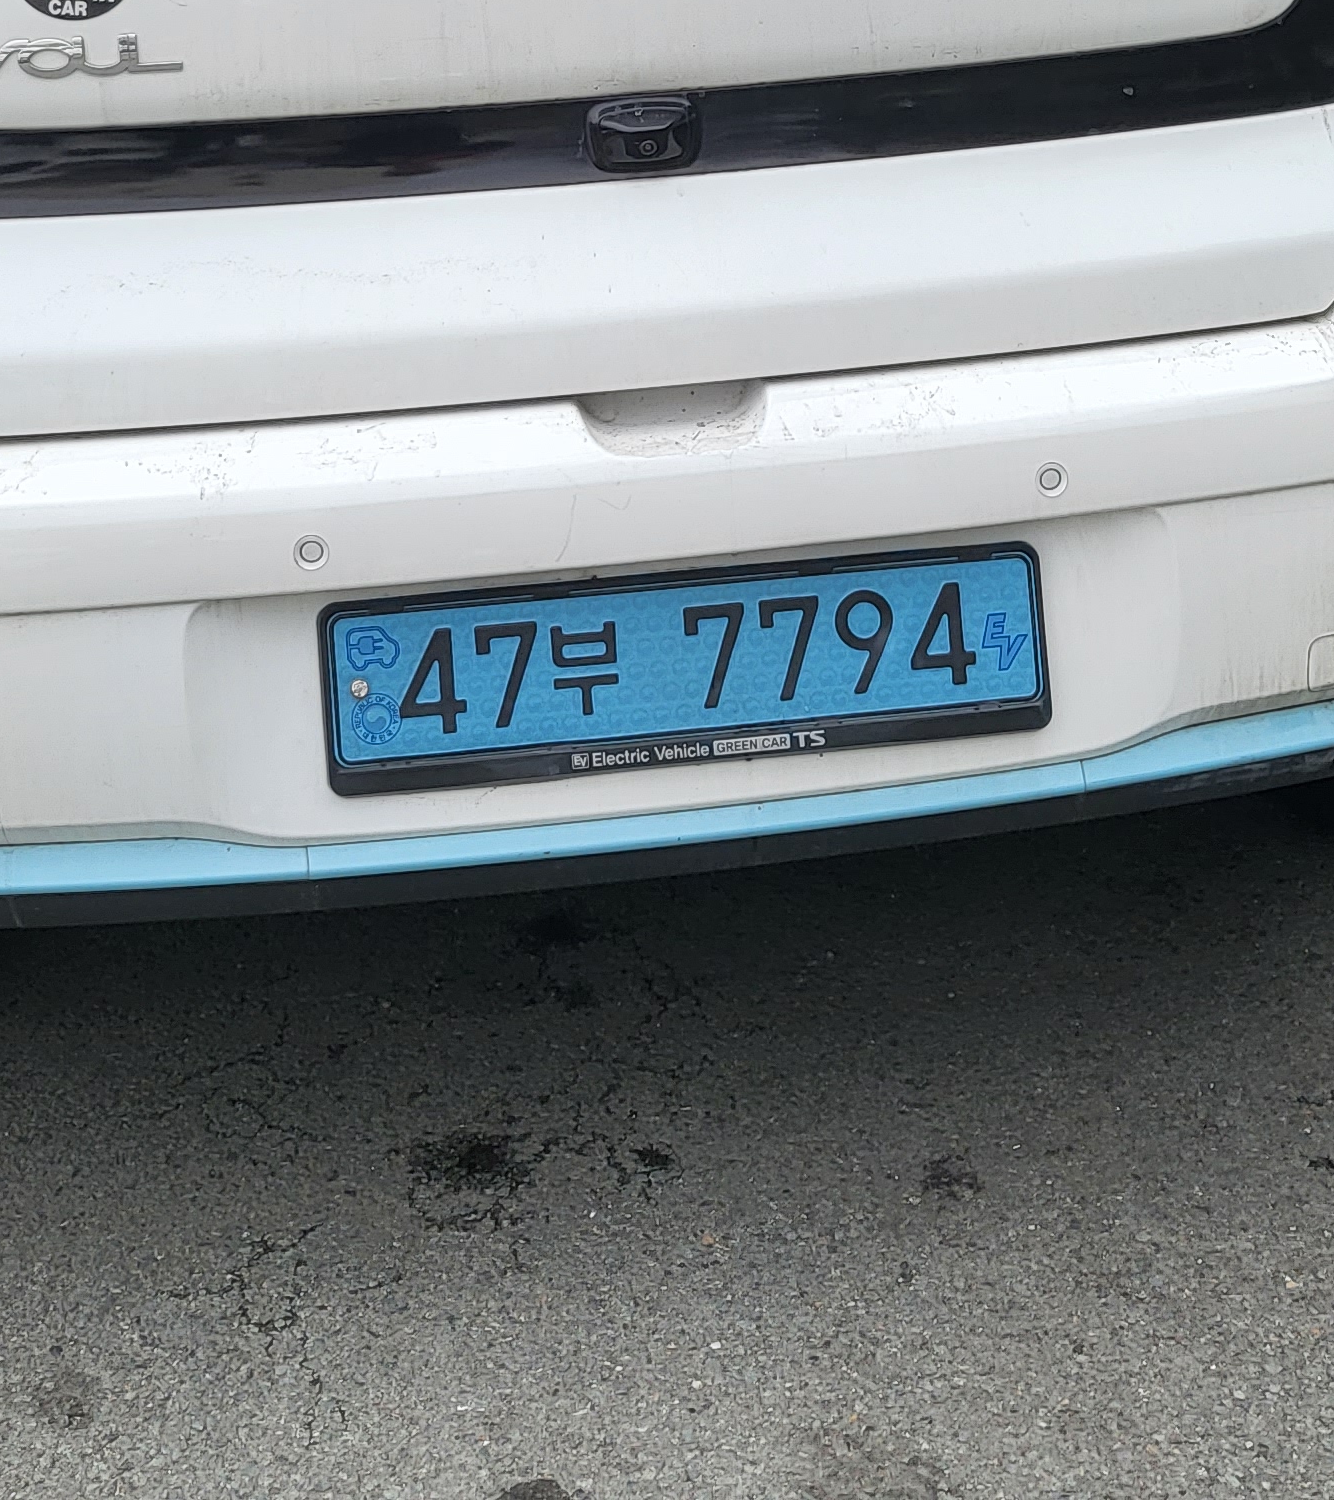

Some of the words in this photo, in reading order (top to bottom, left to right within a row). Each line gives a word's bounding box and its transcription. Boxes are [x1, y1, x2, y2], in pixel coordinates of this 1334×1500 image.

[48, 0, 88, 17] CAR
[399, 620, 620, 735] 47부
[682, 580, 977, 710] 7794
[982, 611, 1028, 672] EV
[591, 747, 650, 768] Electric
[653, 742, 711, 762] Vehicle
[716, 739, 759, 754] GREEN
[761, 735, 788, 749] CAR
[792, 729, 826, 748] TS
